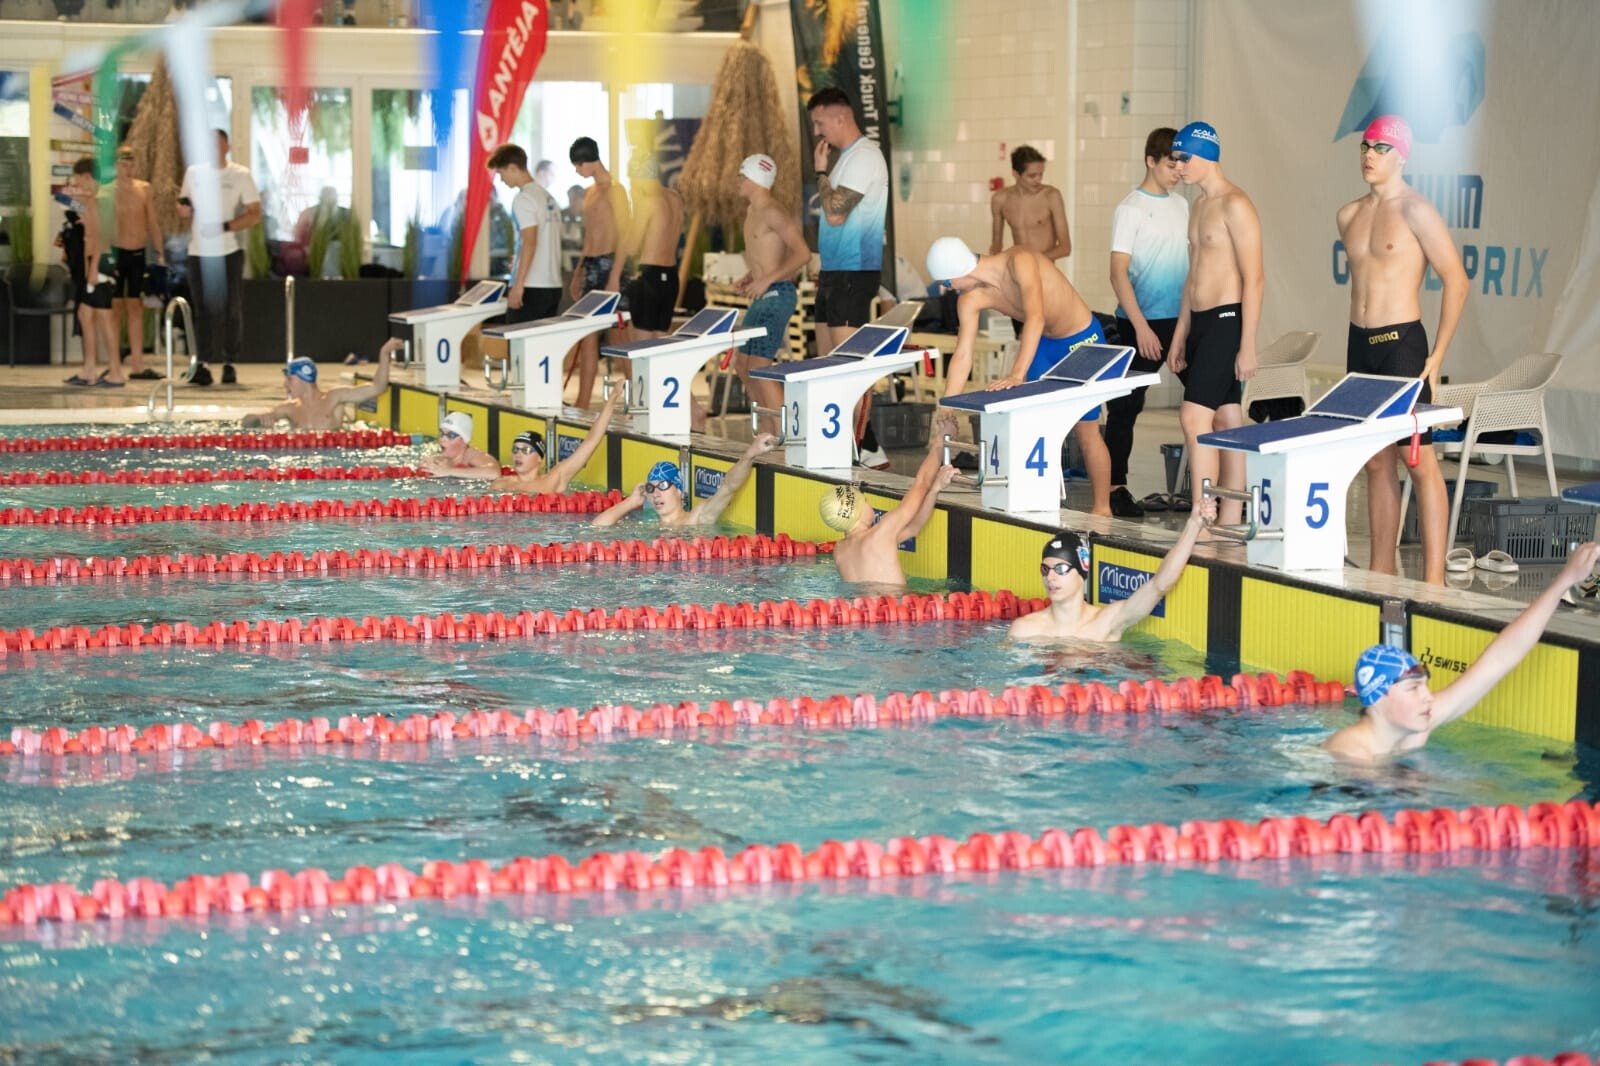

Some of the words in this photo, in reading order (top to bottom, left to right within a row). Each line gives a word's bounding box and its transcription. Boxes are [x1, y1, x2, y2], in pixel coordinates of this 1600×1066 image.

[1462, 244, 1550, 298] PRIX
[437, 338, 450, 364] 0
[1368, 331, 1399, 345] arena
[539, 355, 549, 384] 1
[662, 376, 679, 408] 2
[792, 400, 799, 437] 3
[821, 403, 840, 439] 3
[990, 434, 999, 475] 4
[1025, 436, 1048, 477] 4
[1260, 478, 1272, 526] 5
[1305, 482, 1329, 529] 5
[1434, 656, 1468, 673] SWISS
